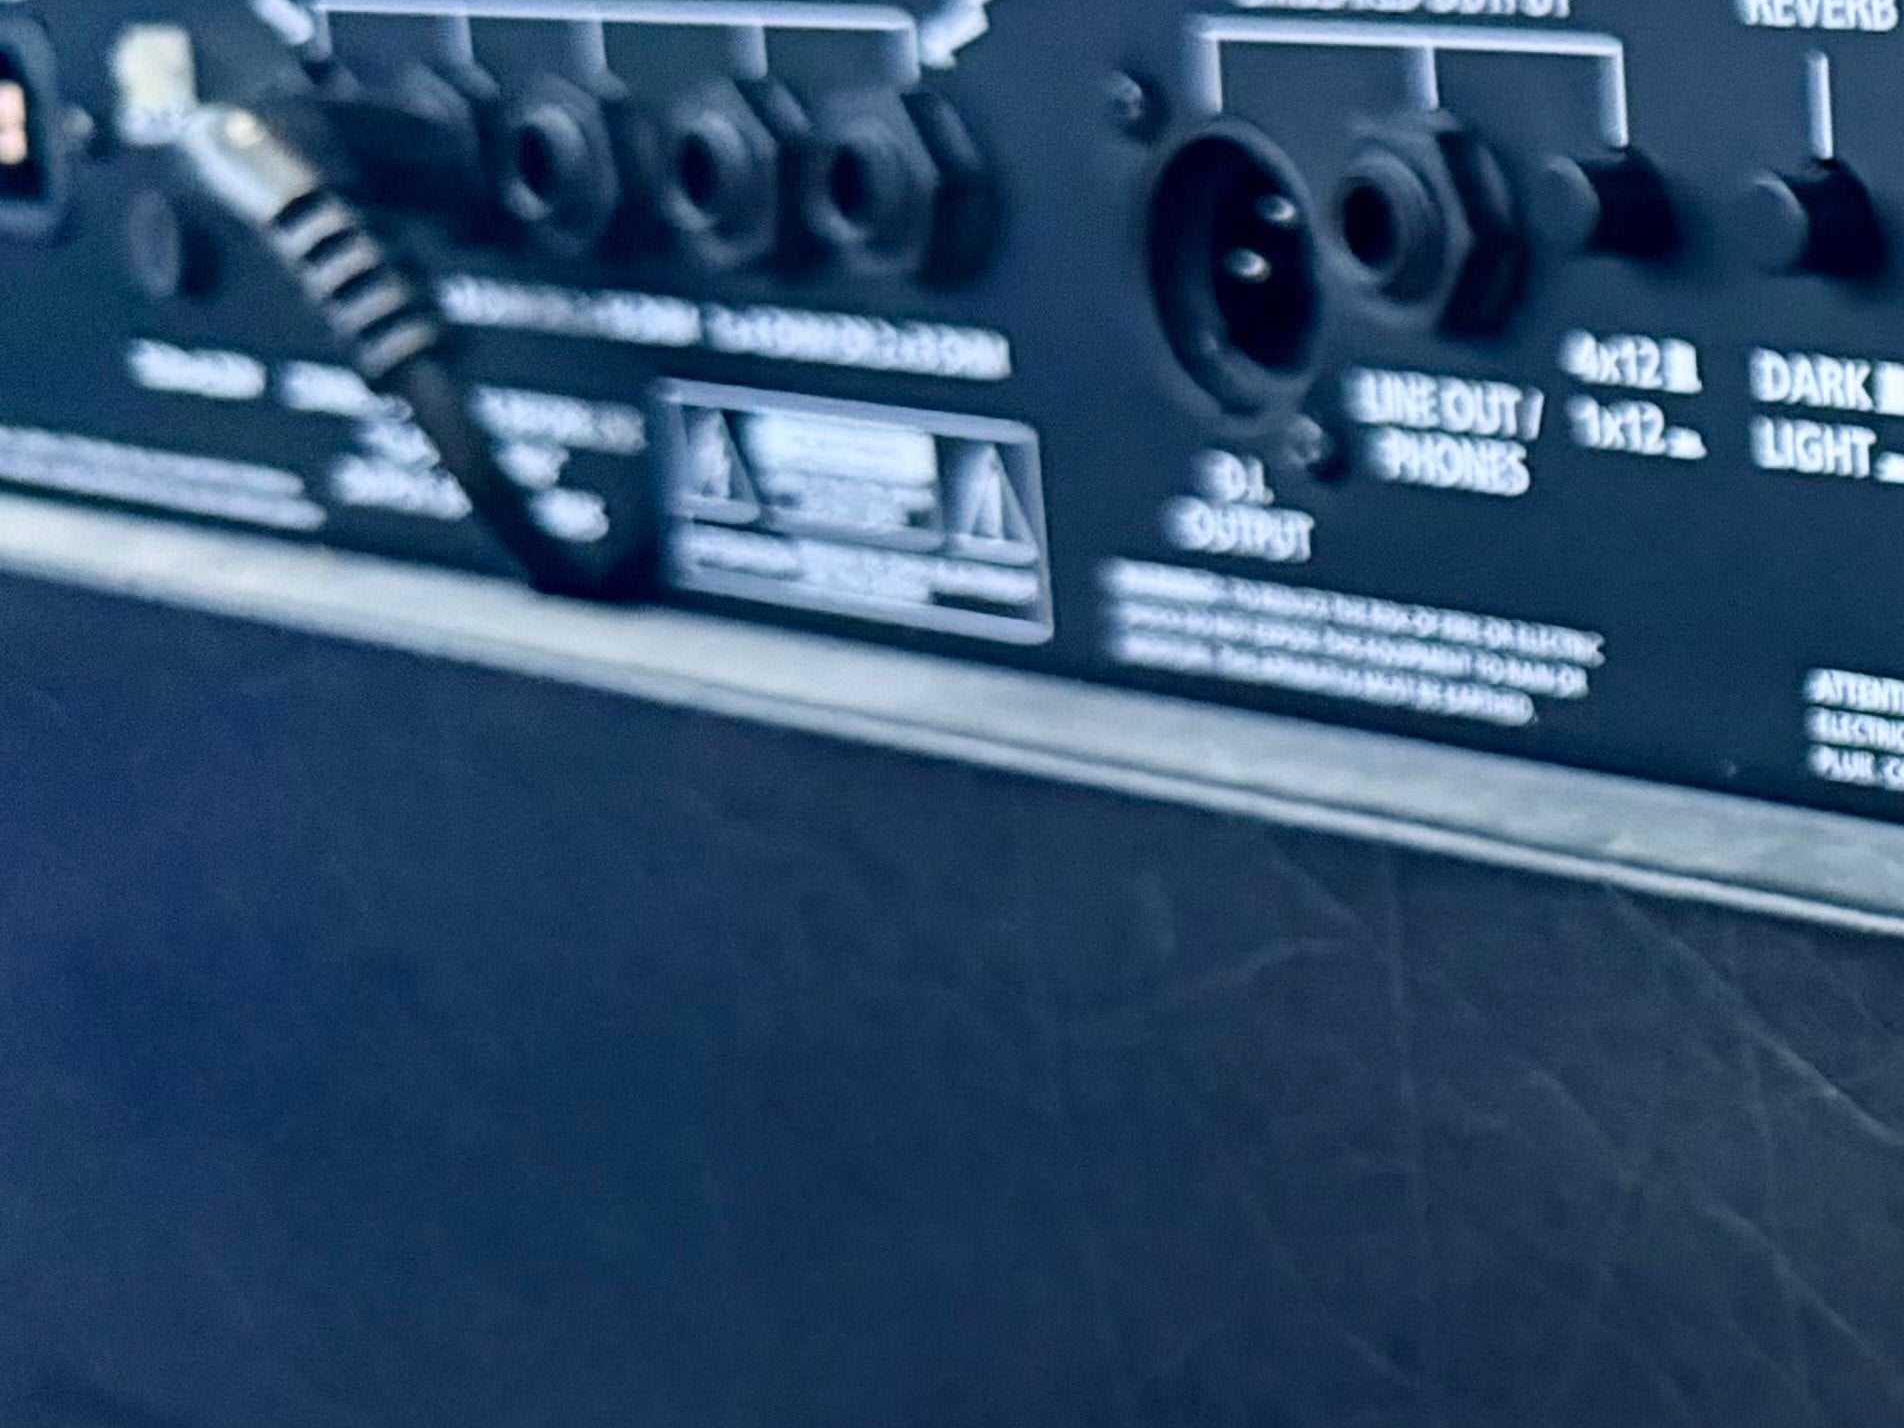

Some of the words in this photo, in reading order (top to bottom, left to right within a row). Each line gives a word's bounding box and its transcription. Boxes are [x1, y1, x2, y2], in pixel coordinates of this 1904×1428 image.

[1559, 328, 1664, 390] 4x12
[1749, 347, 1874, 412] DARK
[1344, 368, 1437, 429] LINE
[1440, 375, 1522, 439] OUT
[1566, 395, 1666, 456] 1x12
[1366, 425, 1530, 497] PHONES
[1749, 414, 1877, 479] LIGHT
[1162, 495, 1315, 562] OUTPUT
